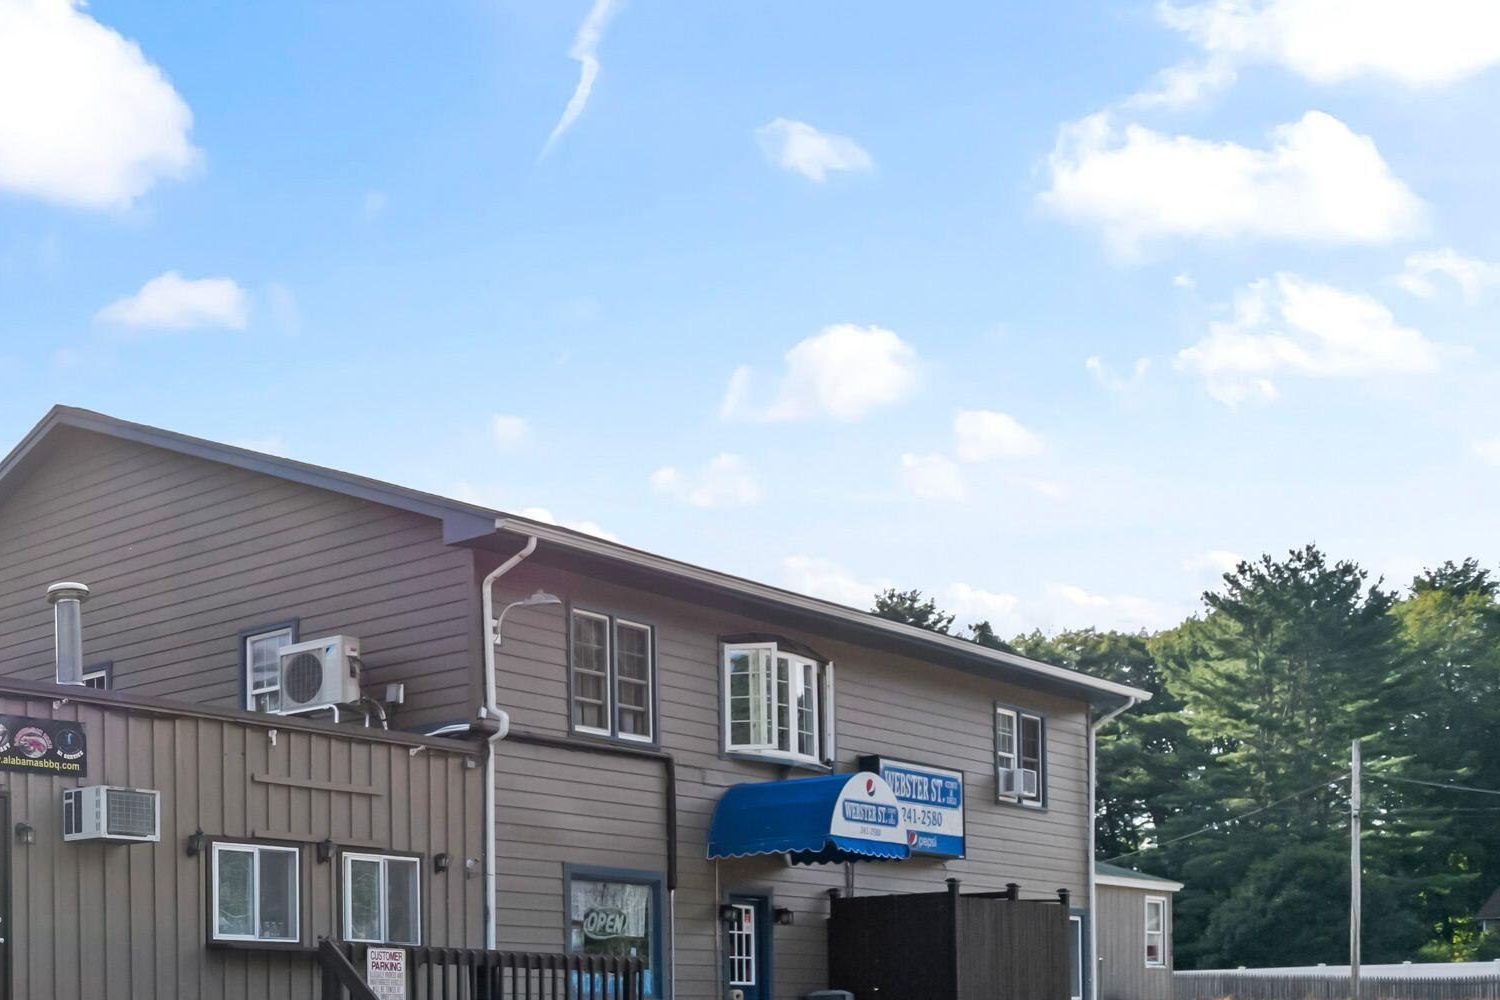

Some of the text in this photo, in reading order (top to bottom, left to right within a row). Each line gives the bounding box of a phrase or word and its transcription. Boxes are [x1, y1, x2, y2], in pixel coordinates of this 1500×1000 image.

[885, 771, 929, 800] WEBSTER
[845, 802, 876, 821] WEBSTER
[902, 807, 942, 826] 241-2580
[918, 836, 938, 849] pepsi
[587, 912, 624, 933] OPEN
[371, 951, 402, 961] CUSTOMER
[372, 962, 402, 971] PARKING
